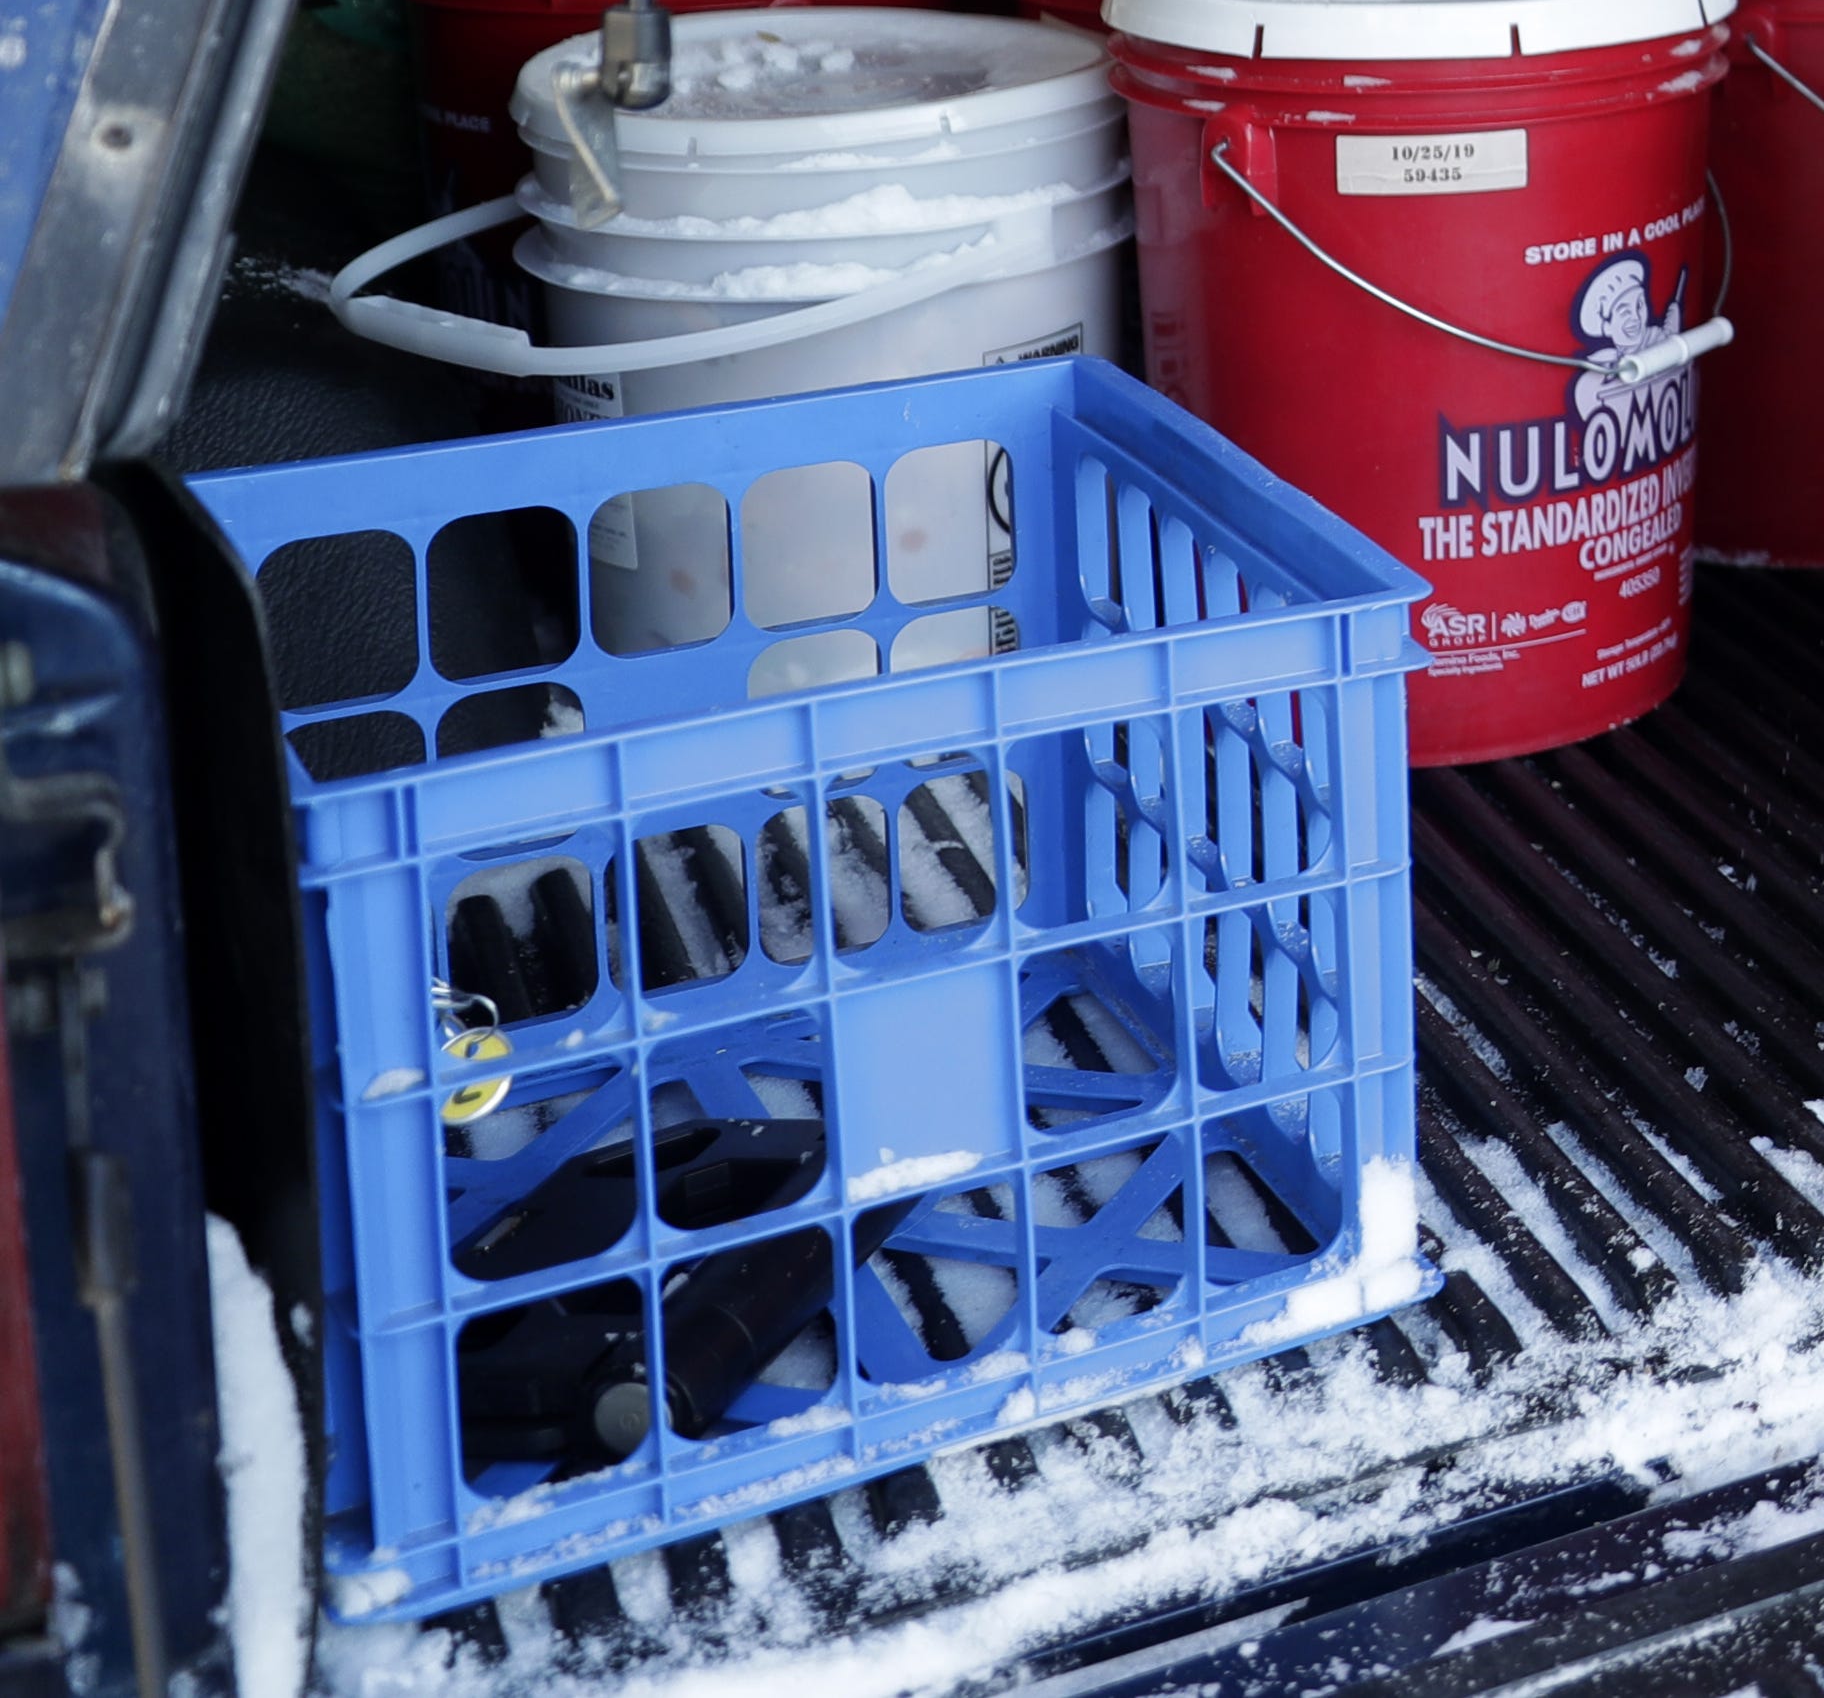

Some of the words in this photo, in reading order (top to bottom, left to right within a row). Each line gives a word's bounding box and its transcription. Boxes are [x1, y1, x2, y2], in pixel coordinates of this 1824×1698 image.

[1392, 143, 1475, 162] 10/25/19
[1404, 167, 1462, 183] 59435
[1524, 237, 1597, 265] STORE
[1602, 231, 1624, 253] IN
[1628, 227, 1642, 247] A
[1644, 212, 1680, 242] COOL
[1419, 514, 1474, 561] THE
[1481, 473, 1660, 557] STANDARDIZED
[1579, 502, 1682, 570] CONGEALED
[1428, 614, 1486, 638] ASR
[1429, 635, 1487, 648] GROUP
